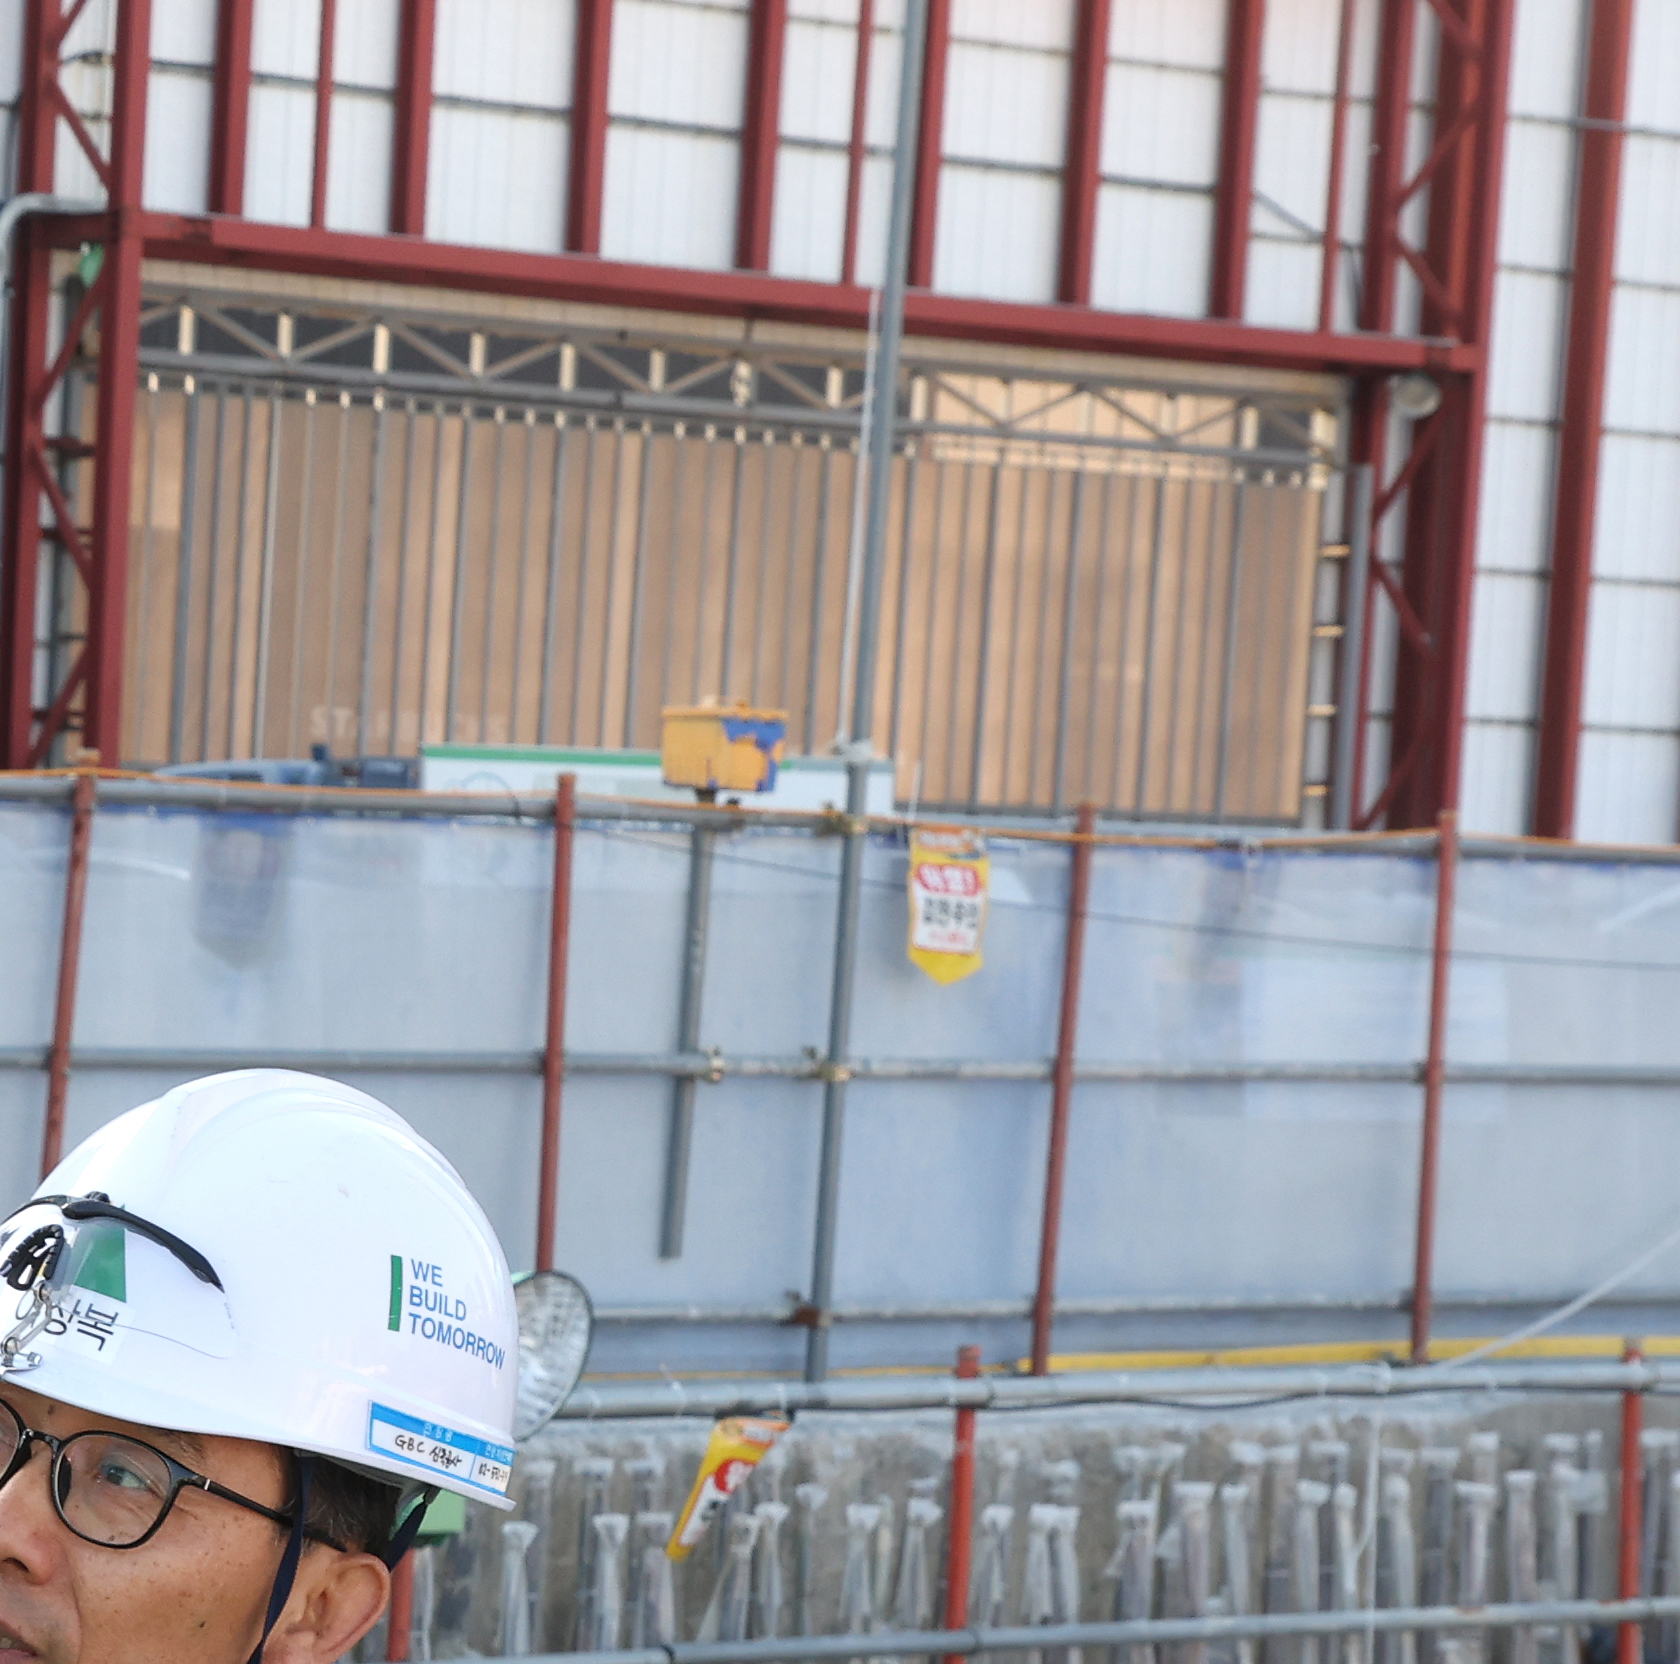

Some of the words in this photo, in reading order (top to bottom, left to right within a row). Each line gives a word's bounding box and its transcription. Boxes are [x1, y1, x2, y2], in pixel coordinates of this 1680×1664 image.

[410, 1258, 443, 1287] WE
[409, 1284, 467, 1321] BUILD
[408, 1312, 506, 1370] TOMORROW
[394, 1434, 425, 1453] GBC
